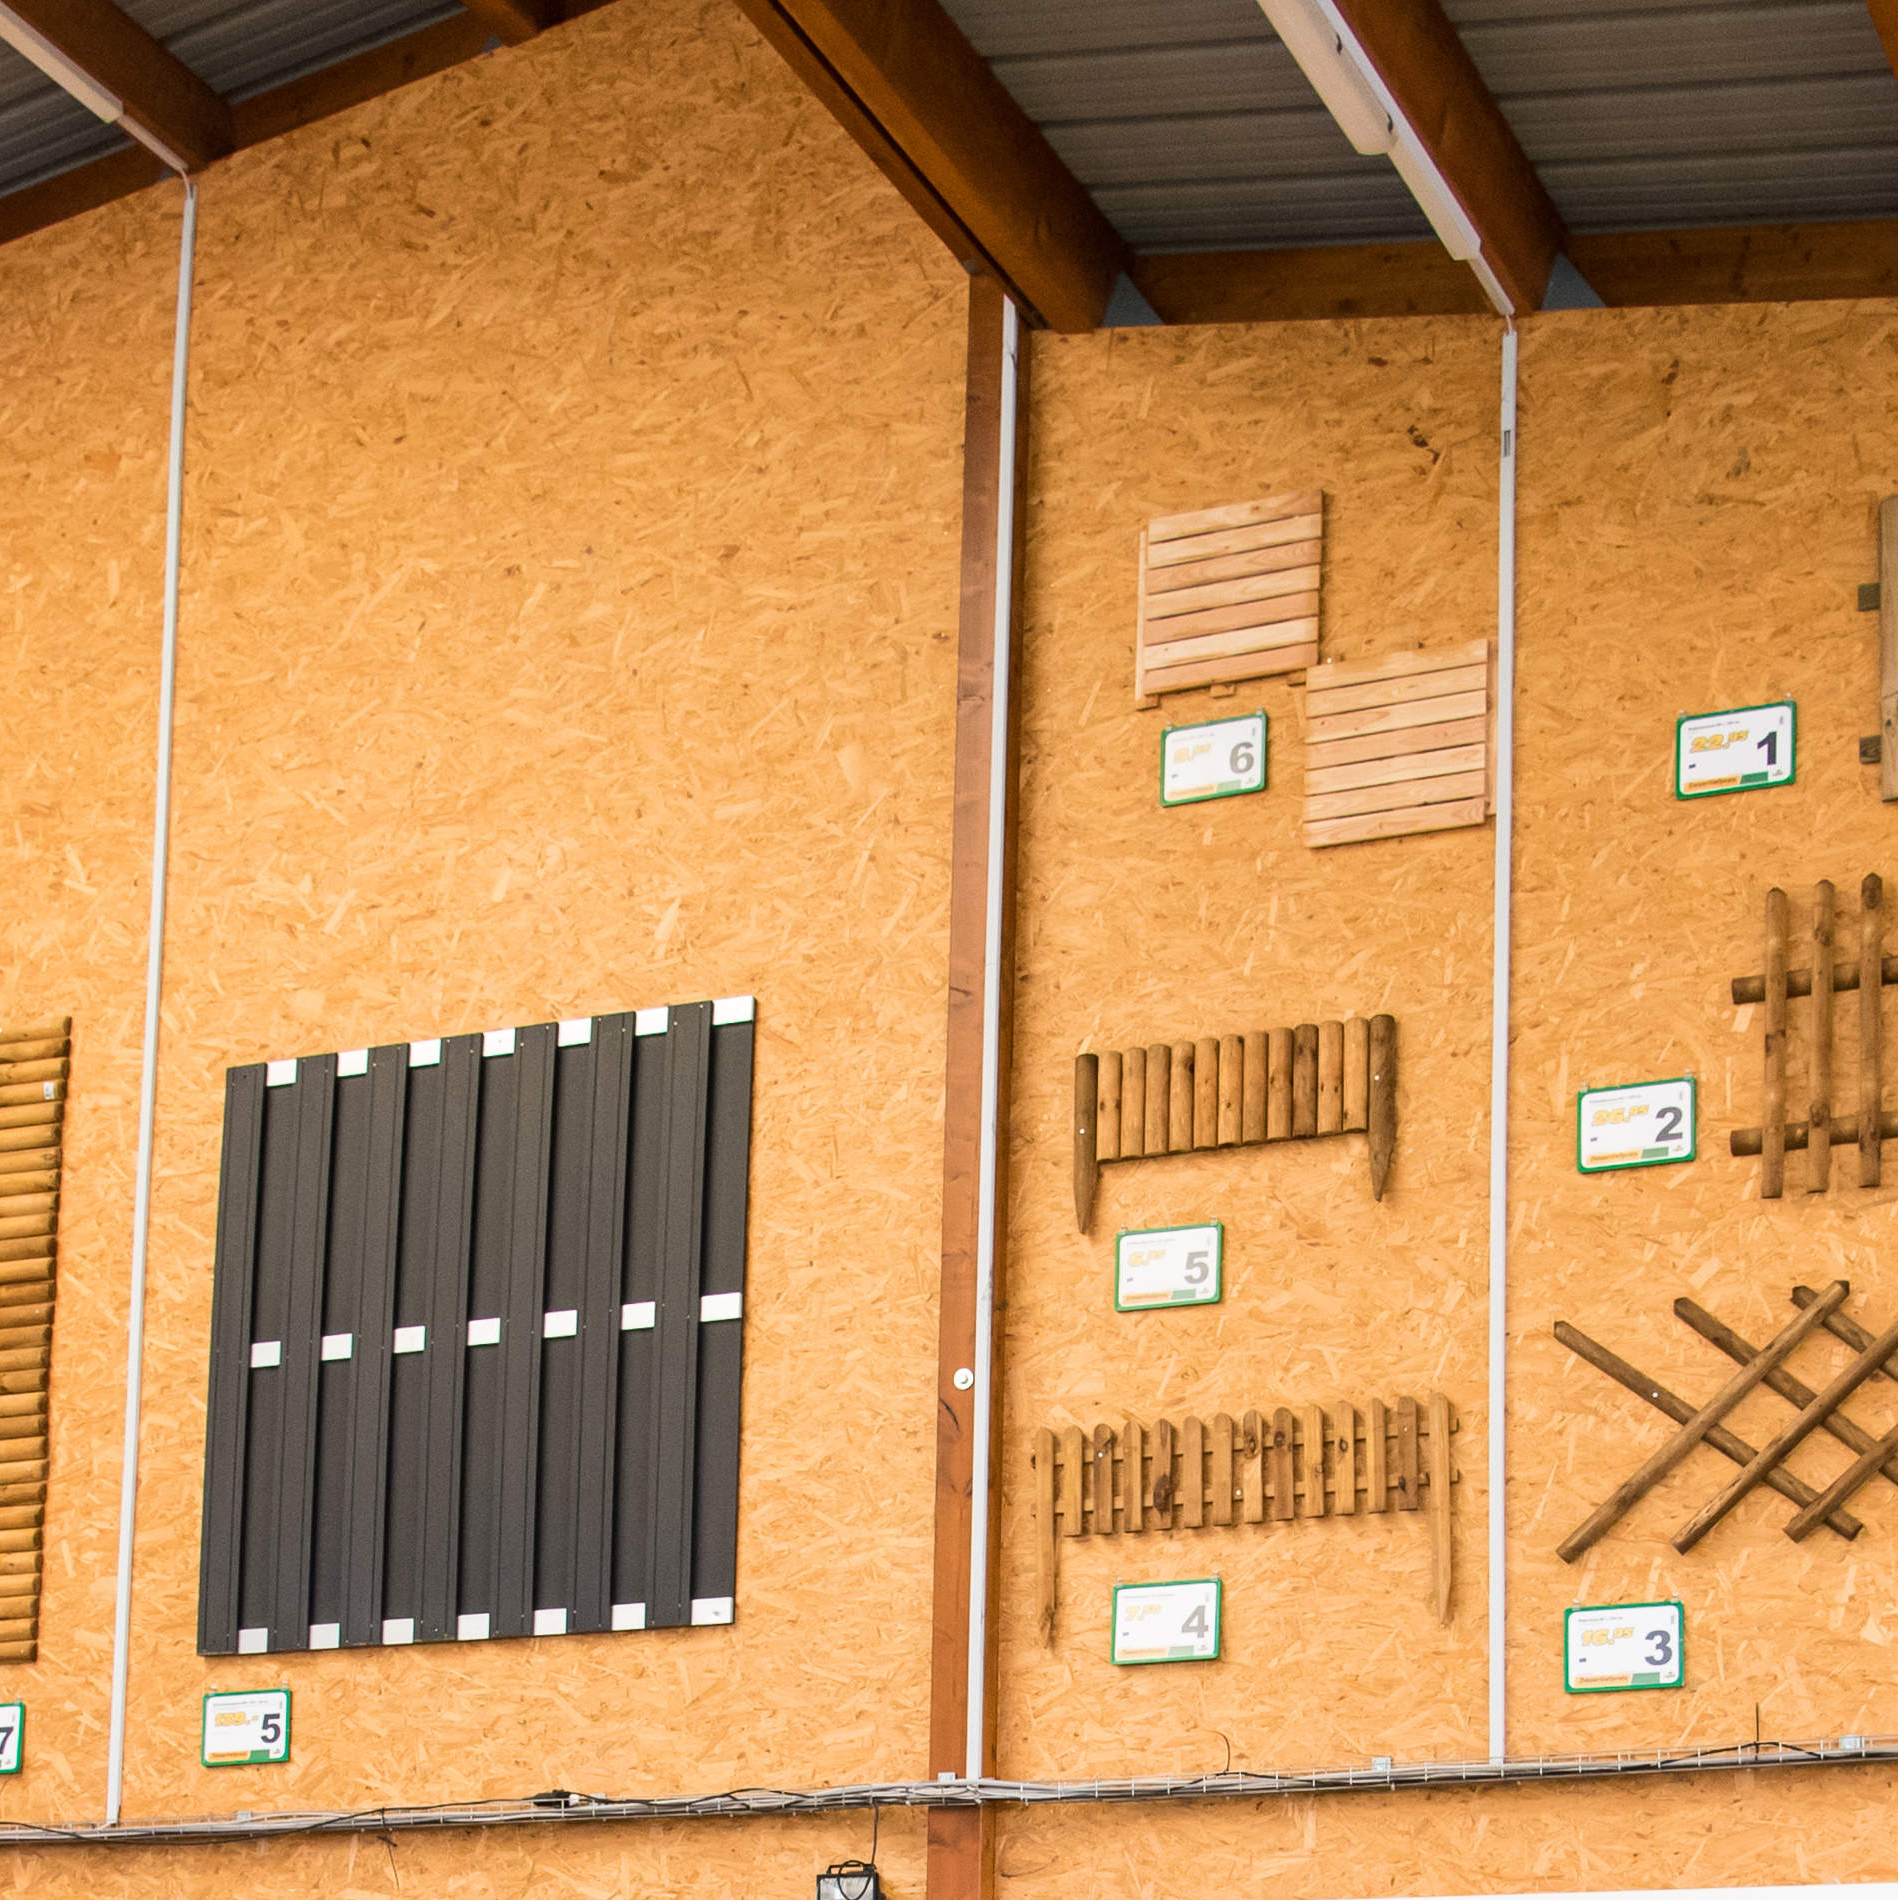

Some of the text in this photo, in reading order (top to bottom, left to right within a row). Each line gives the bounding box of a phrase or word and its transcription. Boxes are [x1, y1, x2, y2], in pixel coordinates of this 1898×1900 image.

[1229, 741, 1255, 774] 6
[1689, 730, 1750, 754] 22.95
[1757, 731, 1777, 766] 1
[1590, 1104, 1650, 1127] 26.95
[1655, 1106, 1684, 1143] 2
[1184, 1250, 1209, 1285] 5
[1181, 1605, 1209, 1639] 4
[1581, 1627, 1635, 1647] 16.95
[1644, 1630, 1673, 1666] 3
[260, 1713, 281, 1743] 5
